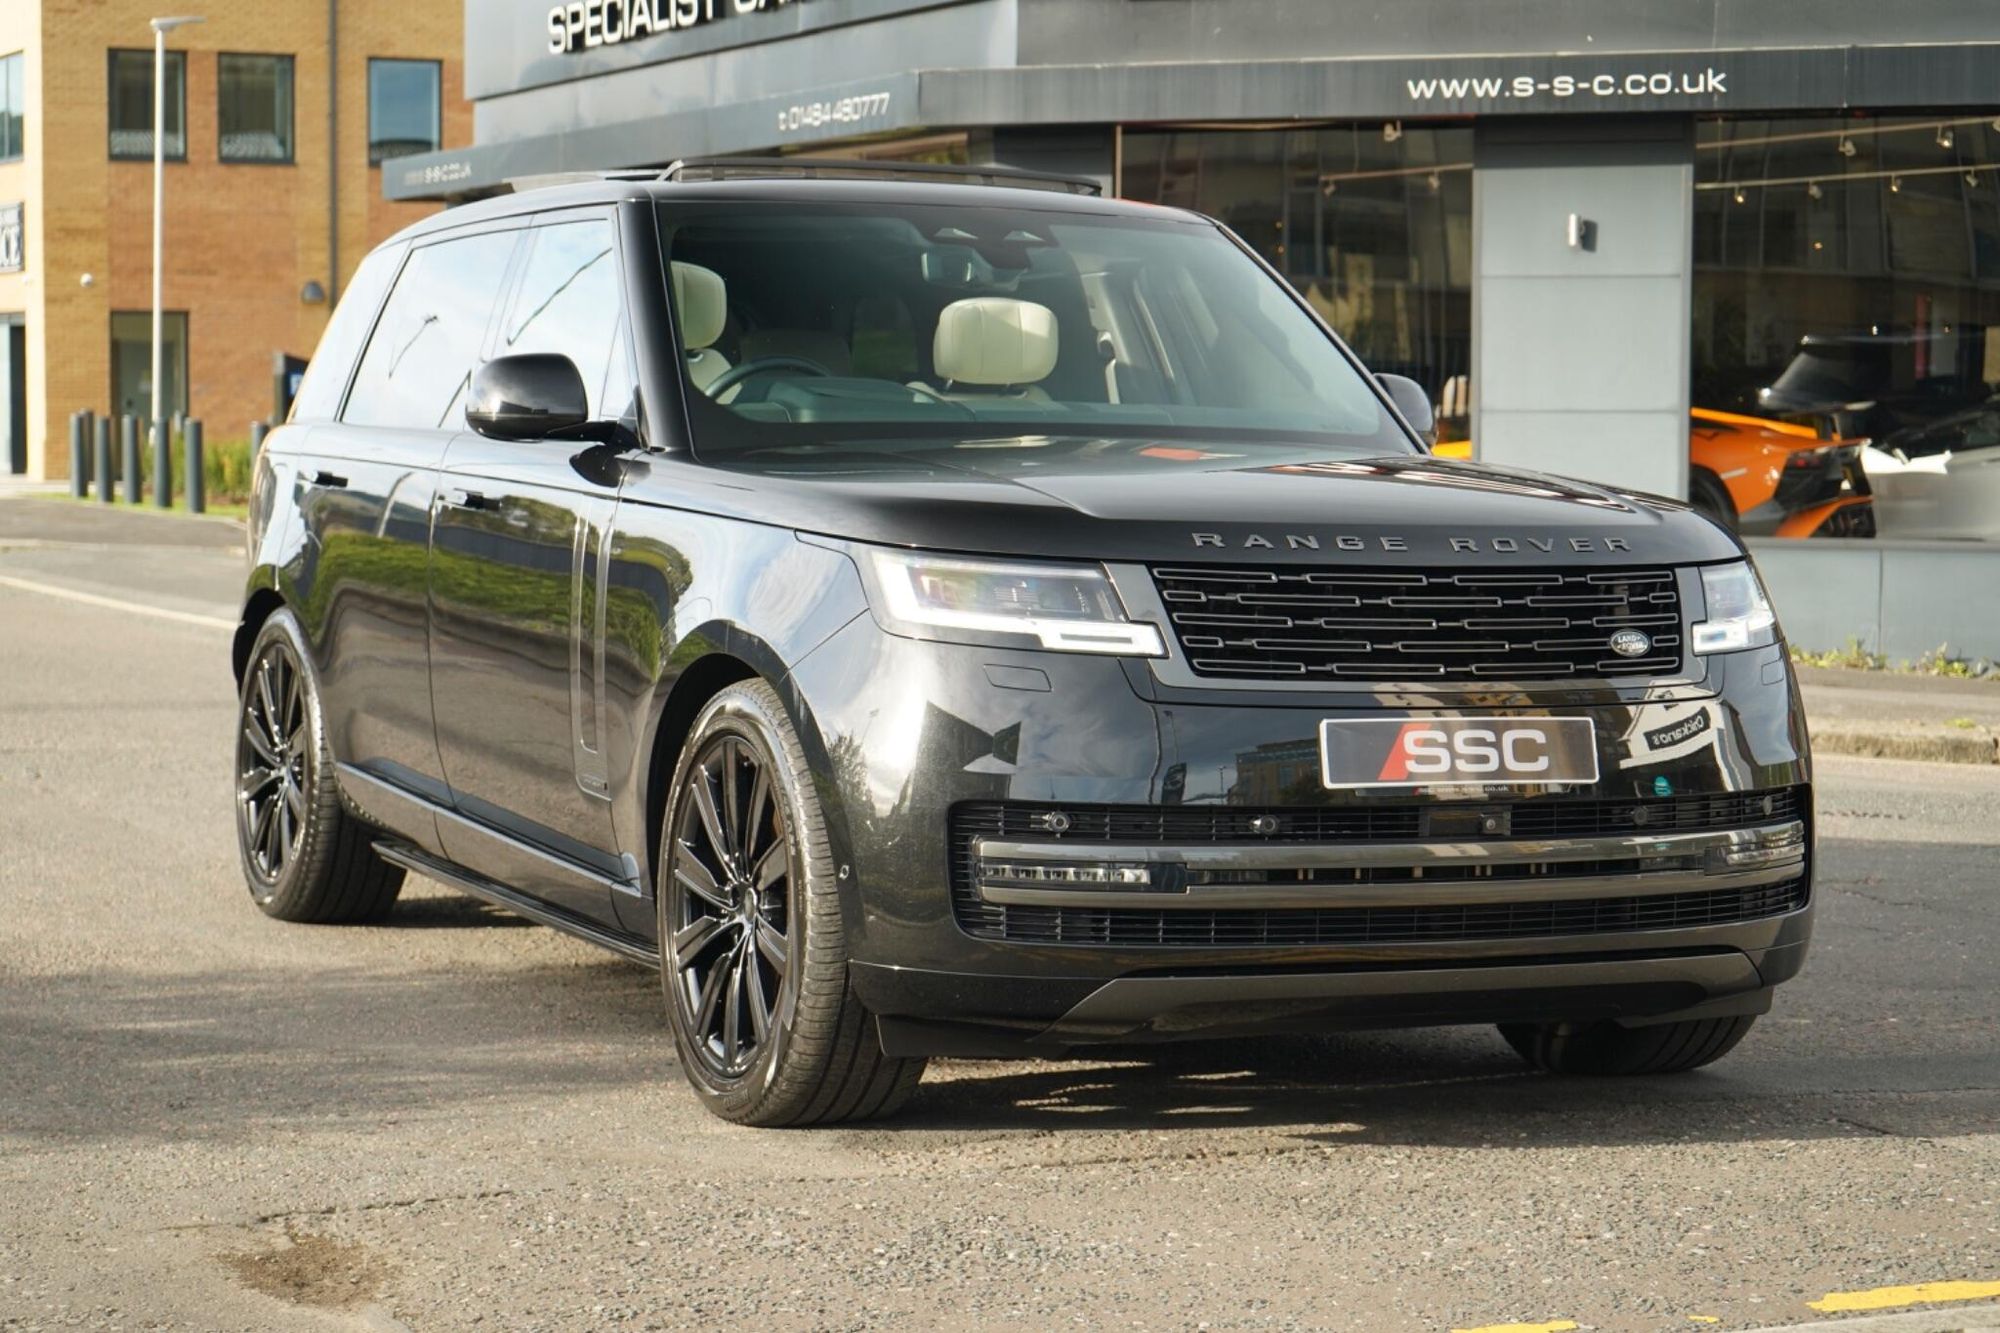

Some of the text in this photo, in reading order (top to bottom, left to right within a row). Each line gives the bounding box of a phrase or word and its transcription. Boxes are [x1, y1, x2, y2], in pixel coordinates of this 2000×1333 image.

[1406, 68, 1728, 99] www.s-s-c.co.uk
[1192, 532, 1632, 552] RANGE ROVER
[1402, 728, 1549, 774] SSC
